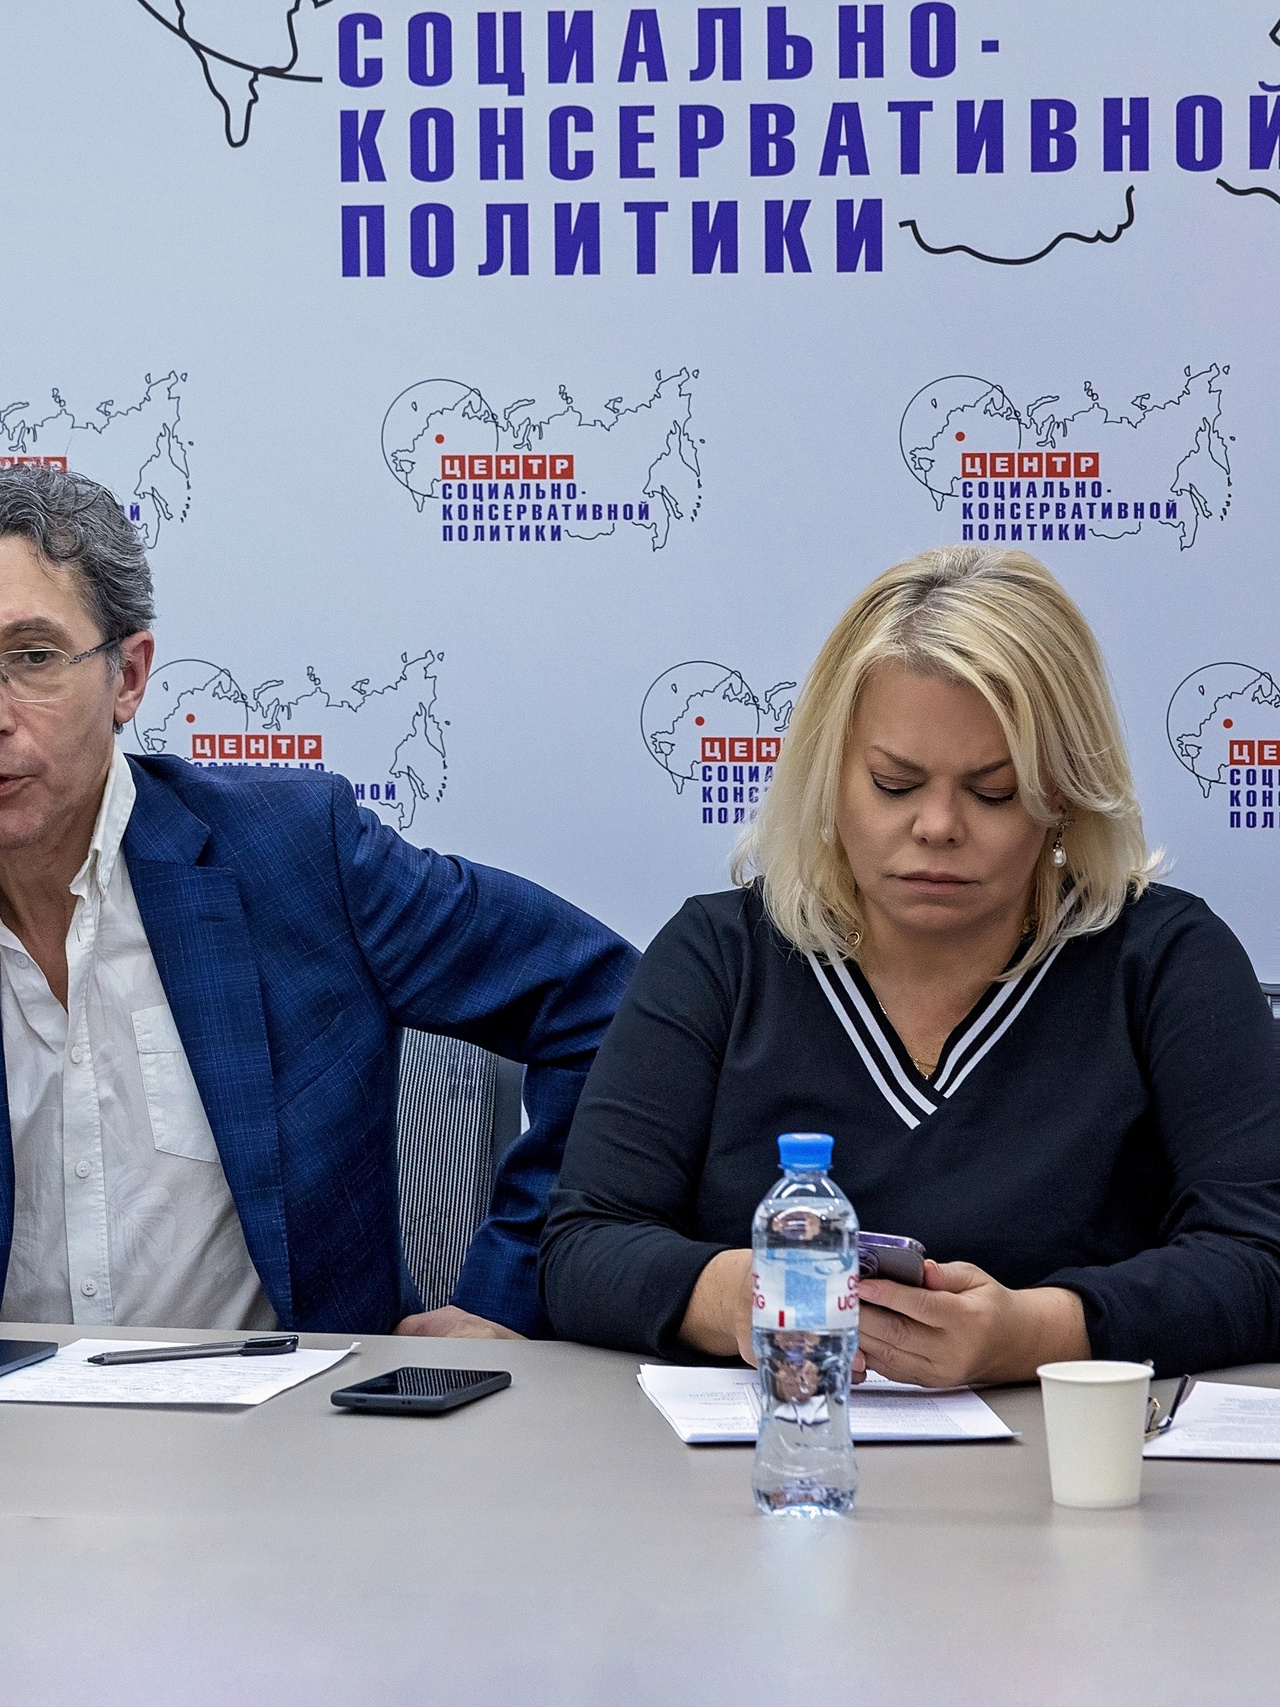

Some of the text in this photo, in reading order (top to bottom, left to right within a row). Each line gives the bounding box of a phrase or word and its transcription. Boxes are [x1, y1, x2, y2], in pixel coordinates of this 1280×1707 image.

[339, 2, 999, 96] СОЦИАЛЬНО-
[340, 81, 1280, 182] КОНСЕРВАТИВНОЙ
[342, 199, 882, 277] ПОЛИТИКИ
[443, 456, 571, 478] ЦЕНТР
[963, 454, 1096, 477] ЦЕНТР
[443, 483, 586, 502] СОЦИАЛЬНО-
[963, 481, 1112, 500] СОЦИАЛЬНО-
[443, 502, 649, 520] КОНСЕРВАТИВНОЙ
[963, 499, 1176, 519] КОНСЕРВАТИВНОЙ
[443, 525, 561, 541] ПОЛИТИКИ
[963, 524, 1085, 540] ПОЛИТИКИ
[195, 736, 319, 758] ЦЕНТР
[703, 739, 778, 761] ЦЕН
[702, 765, 773, 784] СОЦИА
